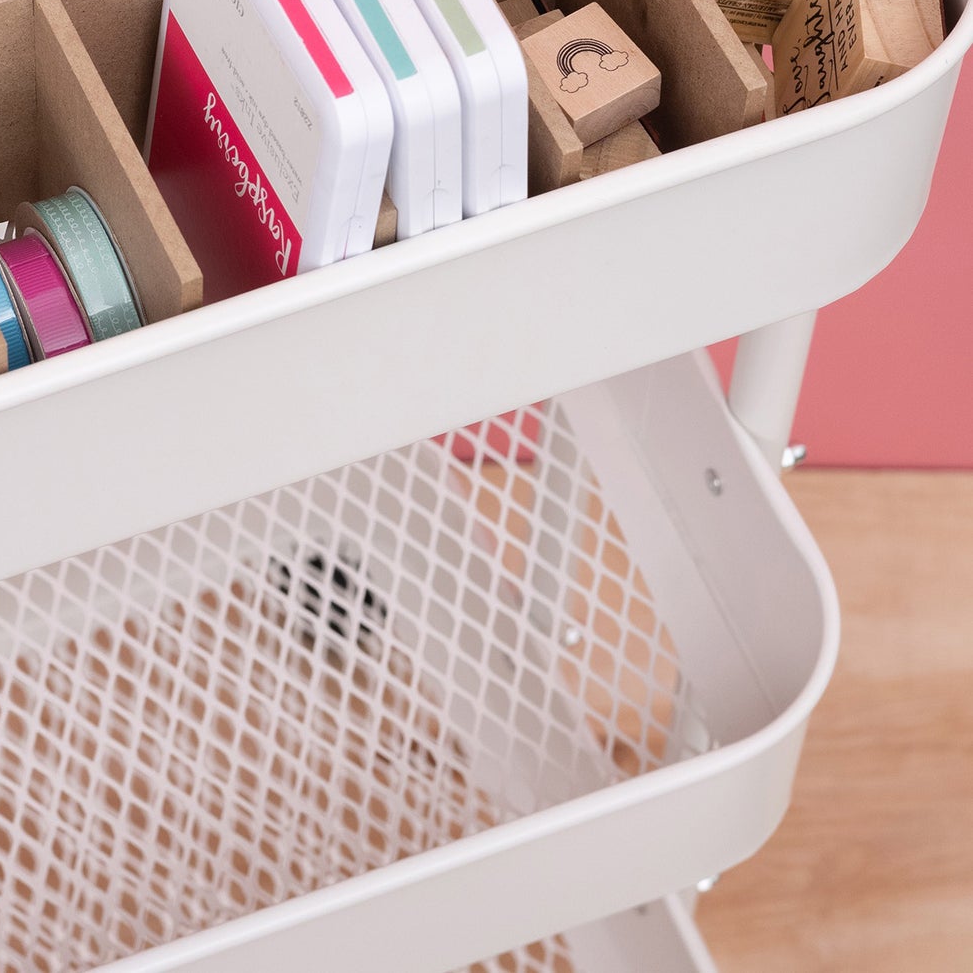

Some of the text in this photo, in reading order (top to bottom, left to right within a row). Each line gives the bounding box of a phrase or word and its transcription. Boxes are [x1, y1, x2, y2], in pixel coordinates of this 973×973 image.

[837, 30, 848, 71] AND
[202, 91, 293, 277] Raspberry
[255, 122, 300, 204] Exclusive
